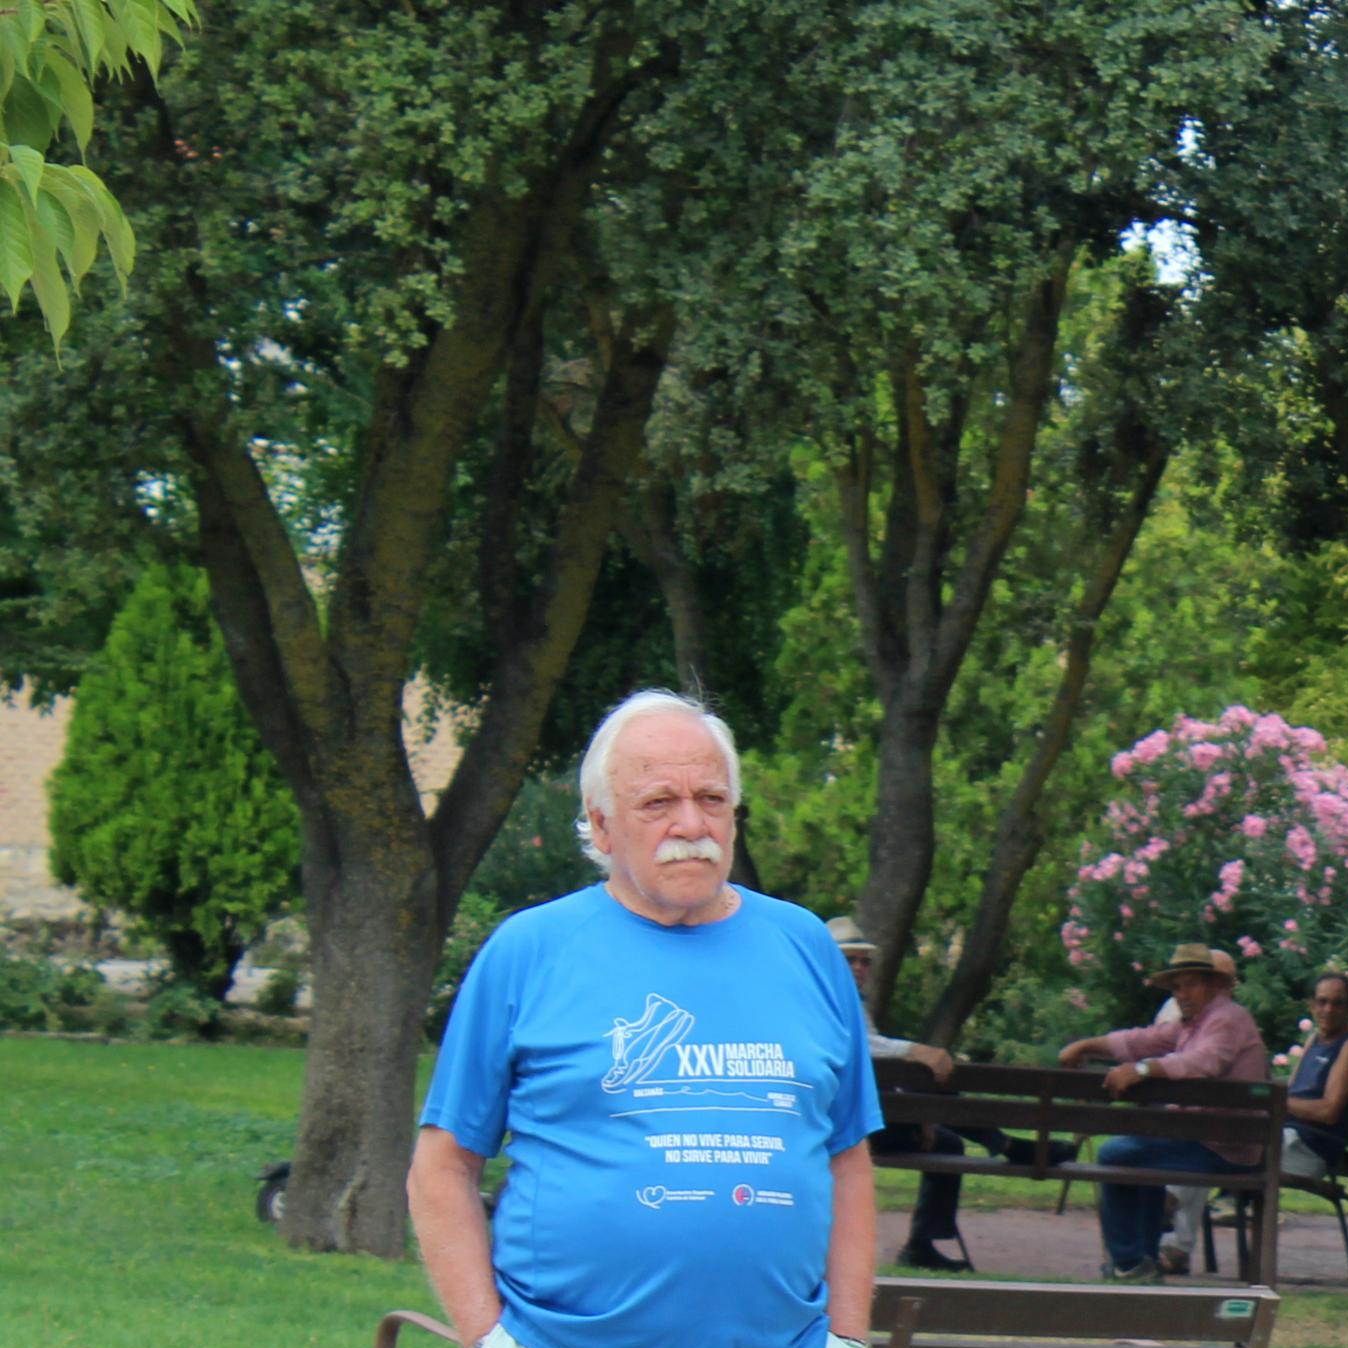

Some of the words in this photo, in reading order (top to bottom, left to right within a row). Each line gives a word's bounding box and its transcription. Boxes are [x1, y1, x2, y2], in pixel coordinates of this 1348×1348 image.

[674, 1043, 724, 1077] XXV
[725, 1043, 784, 1059] MARCHA
[726, 1060, 795, 1078] SOLIDARIA
[682, 1133, 698, 1148] NO
[699, 1133, 723, 1148] VIVE
[723, 1134, 751, 1149] PARA
[665, 1150, 680, 1163] NO
[681, 1149, 713, 1163] SIRVE
[713, 1149, 742, 1164] PARA
